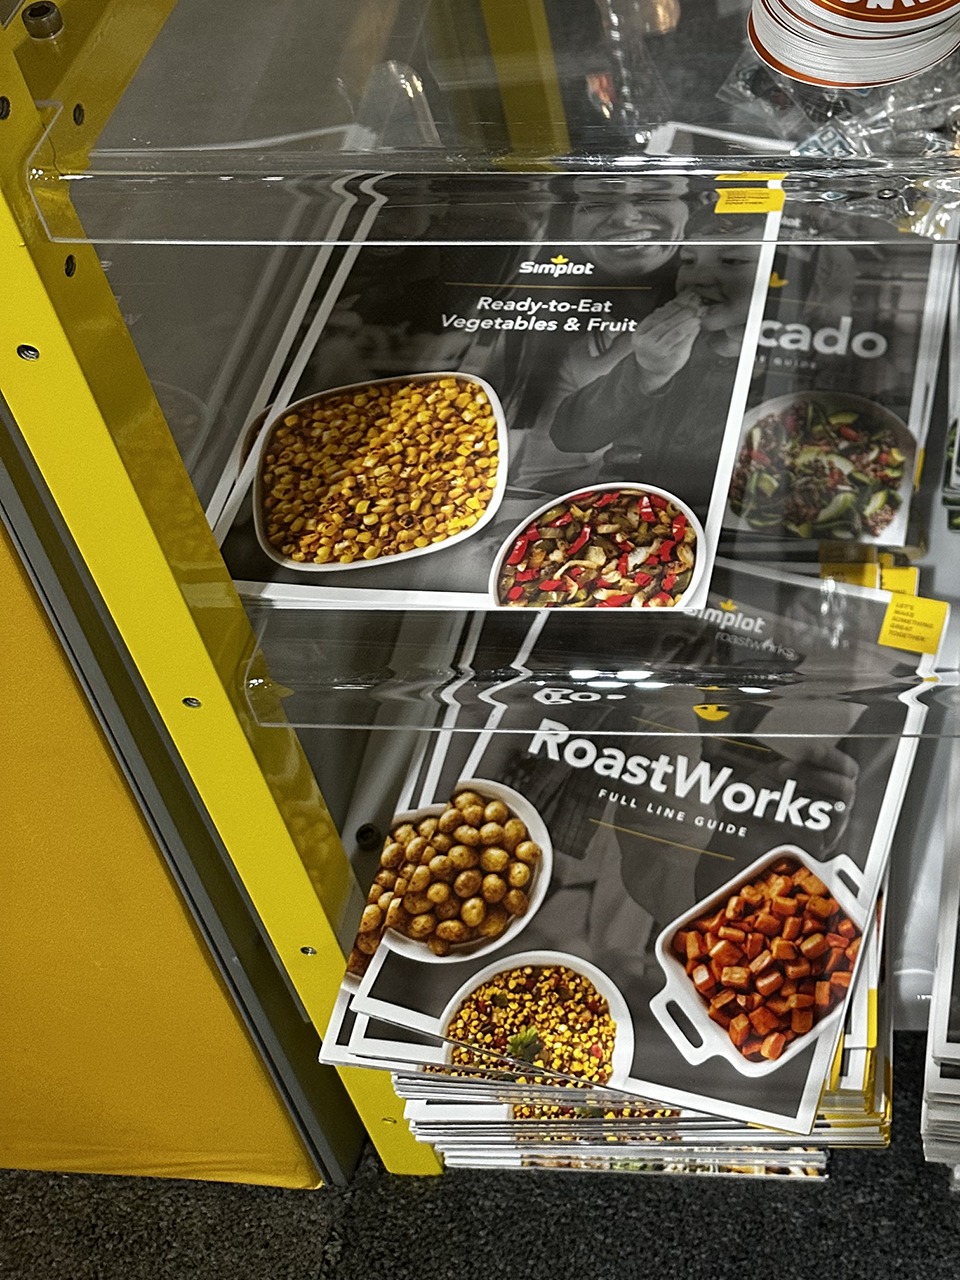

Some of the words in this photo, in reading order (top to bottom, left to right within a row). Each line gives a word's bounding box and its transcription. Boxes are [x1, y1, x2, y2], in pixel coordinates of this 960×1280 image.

[519, 261, 595, 278] Simplot
[476, 296, 613, 314] Ready-to-Eat
[441, 314, 558, 332] Vegetables
[563, 318, 580, 331] &
[586, 318, 638, 332] Fruit
[597, 788, 638, 809] FULL
[646, 802, 687, 822] LINE
[694, 816, 749, 838] GUIDE
